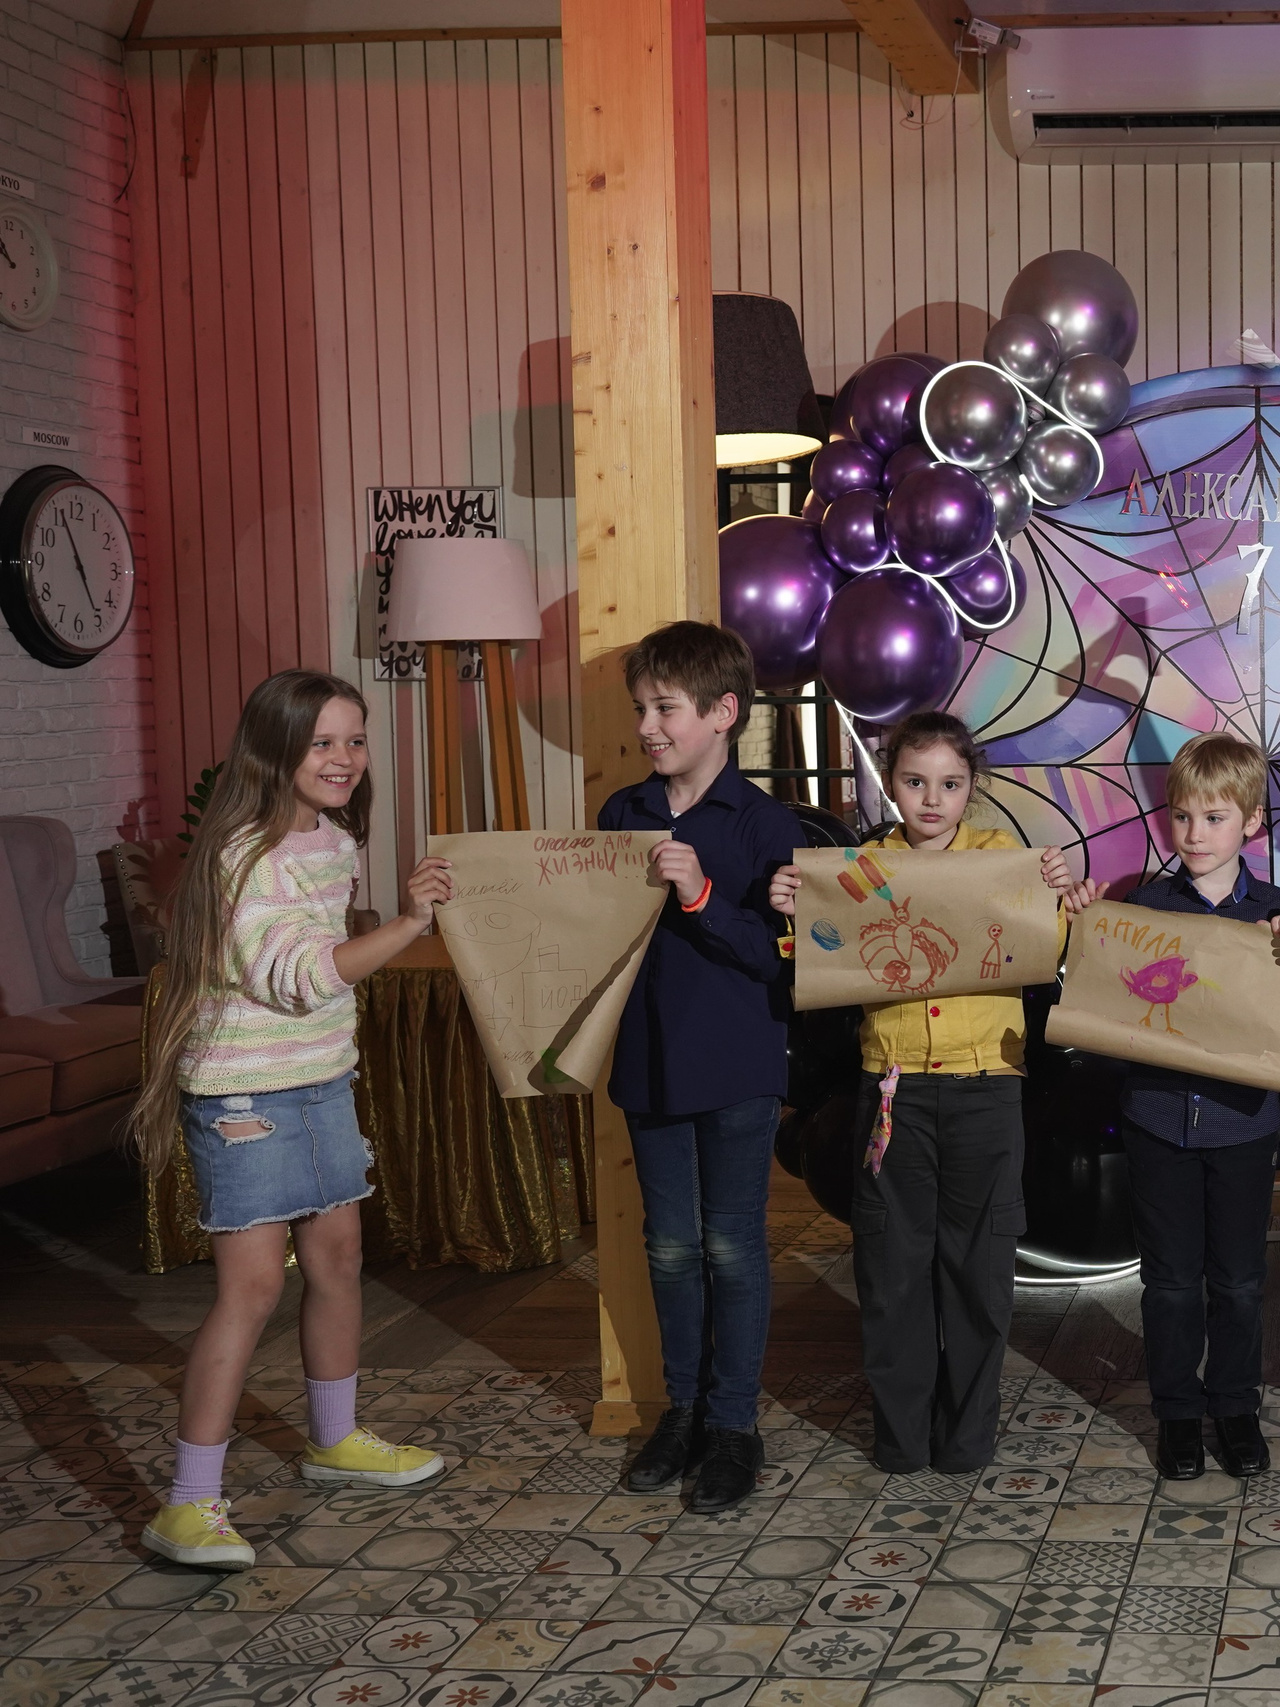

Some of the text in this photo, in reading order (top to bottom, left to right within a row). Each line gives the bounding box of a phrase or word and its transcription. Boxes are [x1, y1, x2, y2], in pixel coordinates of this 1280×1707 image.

[0, 175, 20, 191] KYO
[4, 220, 14, 232] 12
[20, 229, 24, 240] 1
[30, 246, 35, 256] 2
[35, 268, 40, 278] 3
[32, 286, 37, 296] 4
[11, 301, 17, 311] 6
[24, 299, 29, 309] 5
[33, 431, 70, 447] MOSCOW
[69, 501, 84, 521] 12
[91, 512, 97, 532] 1
[40, 527, 56, 548] 10
[102, 532, 111, 550] 2
[34, 551, 44, 572] 9
[110, 562, 119, 581] 3
[41, 582, 51, 602] 8
[1236, 542, 1274, 635] 7
[104, 589, 113, 608] 4
[57, 604, 66, 623] 7
[73, 612, 84, 633] 6
[94, 608, 102, 628] 5
